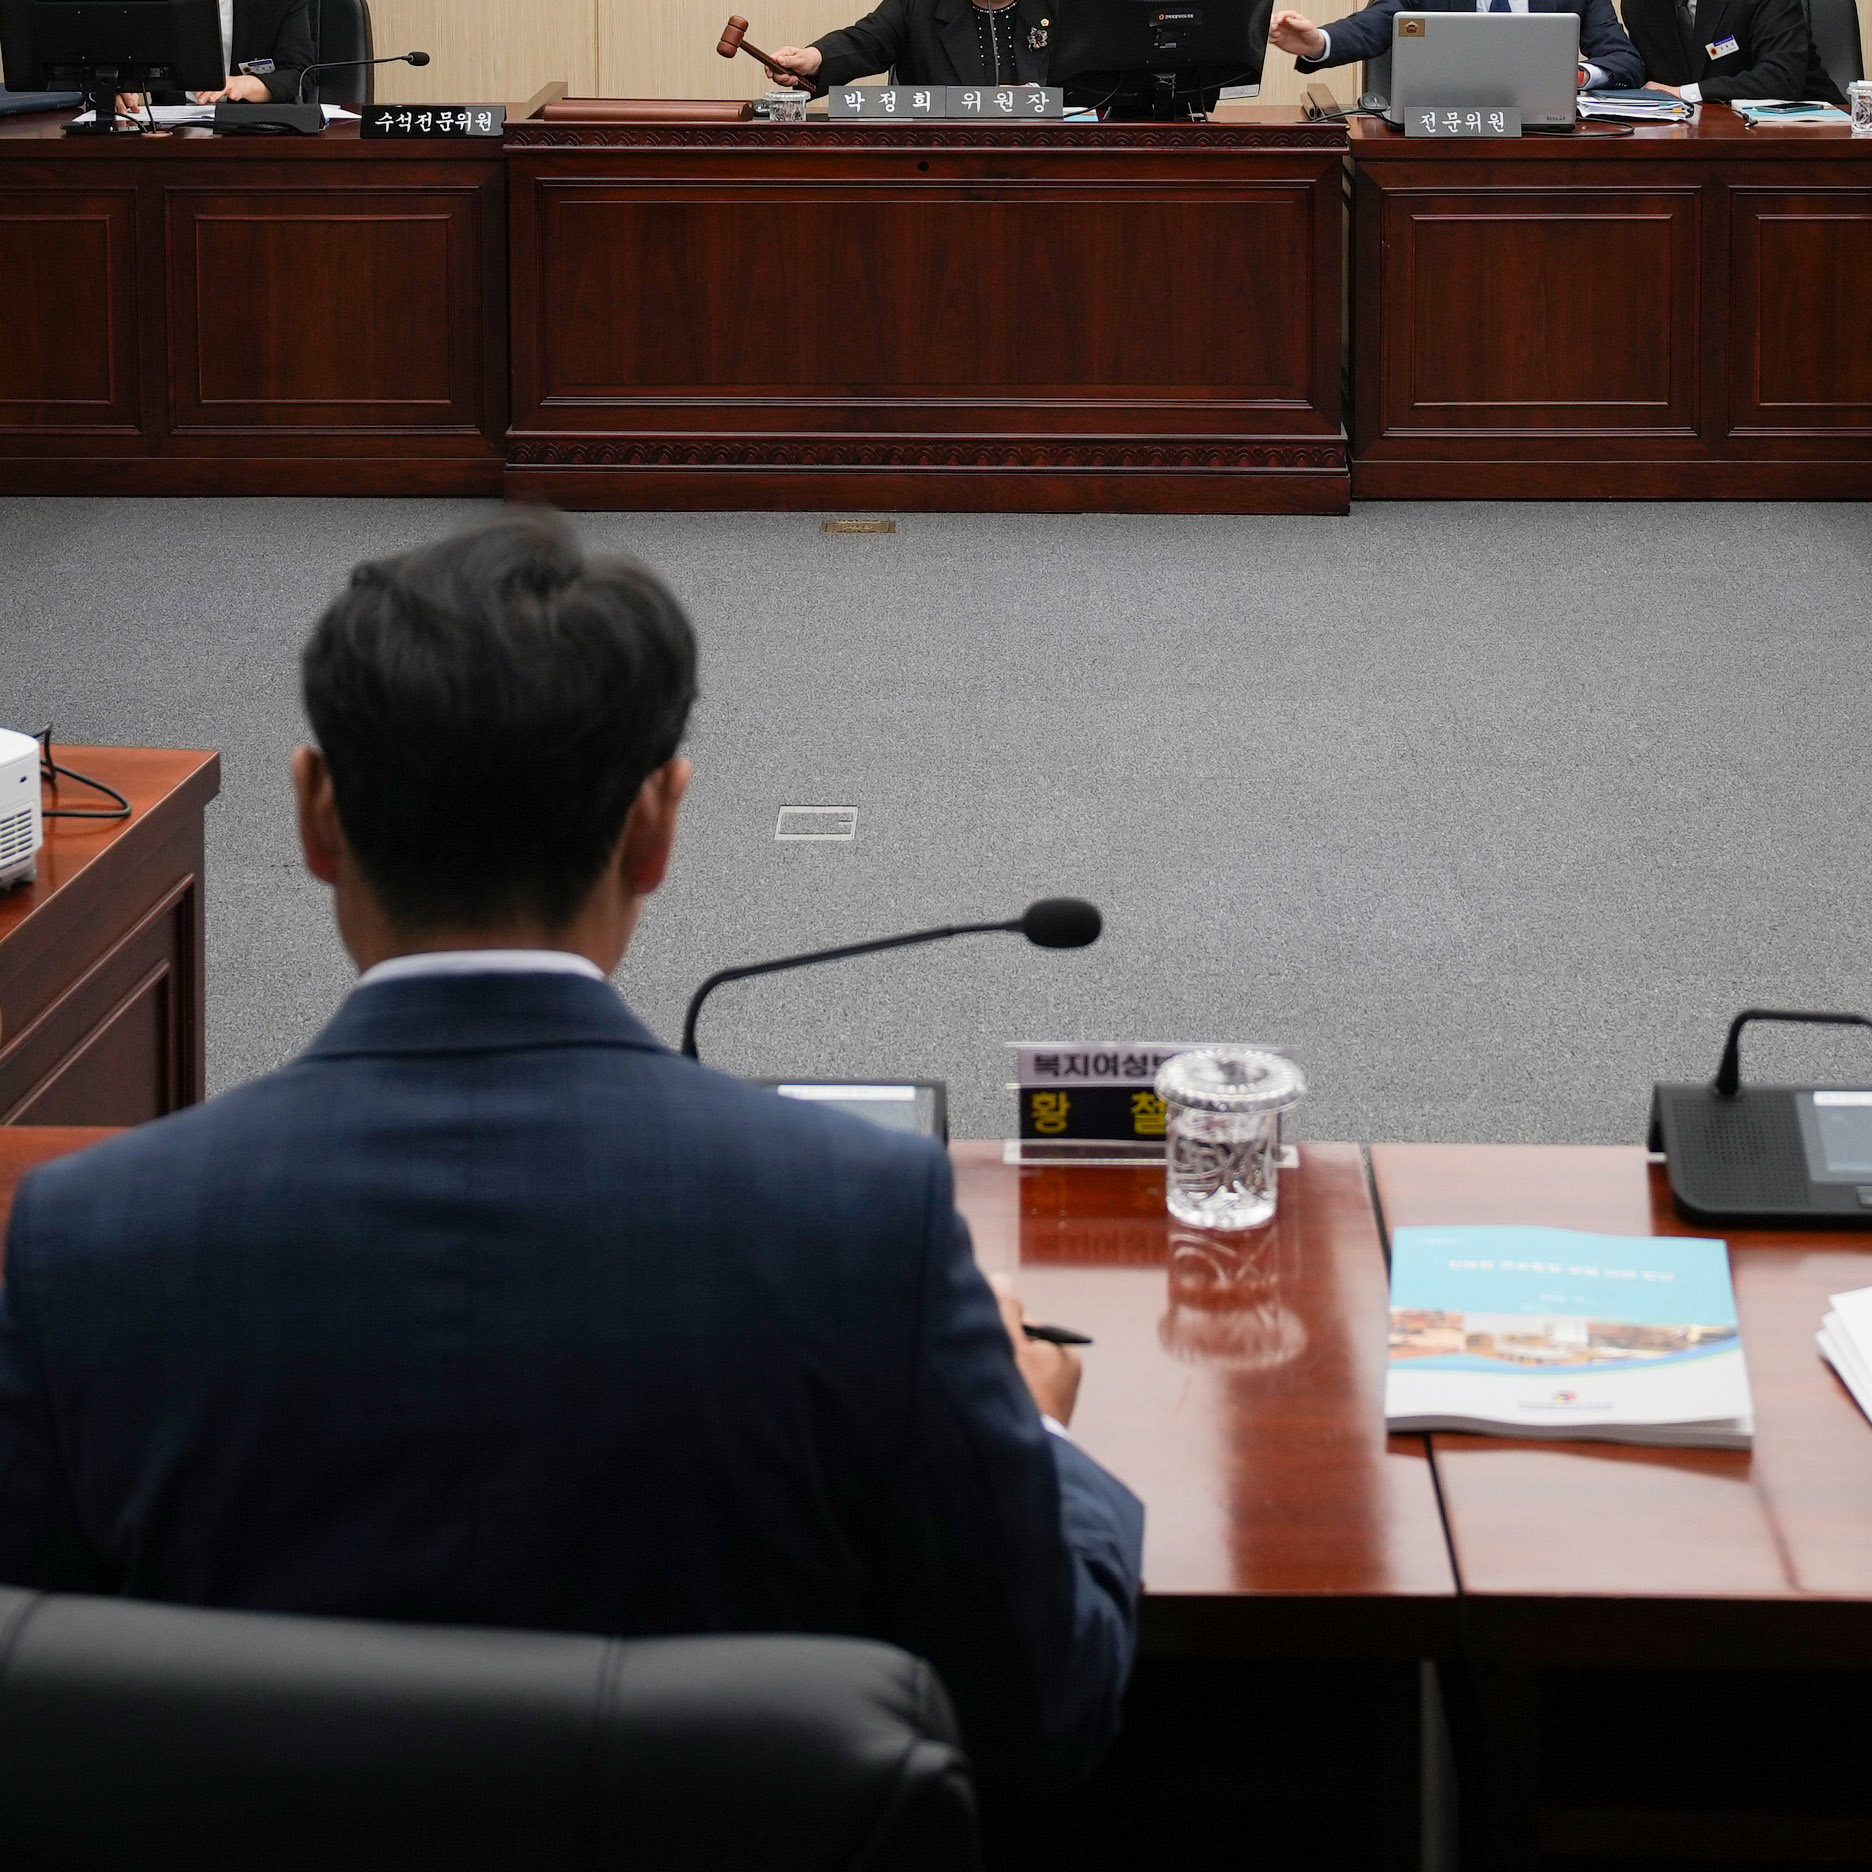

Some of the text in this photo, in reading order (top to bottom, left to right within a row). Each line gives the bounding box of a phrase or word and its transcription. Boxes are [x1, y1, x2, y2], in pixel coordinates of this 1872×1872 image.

[843, 90, 1050, 113] 박정희 위원장
[374, 111, 492, 133] 수석전문위원
[1419, 111, 1506, 133] 전문위원
